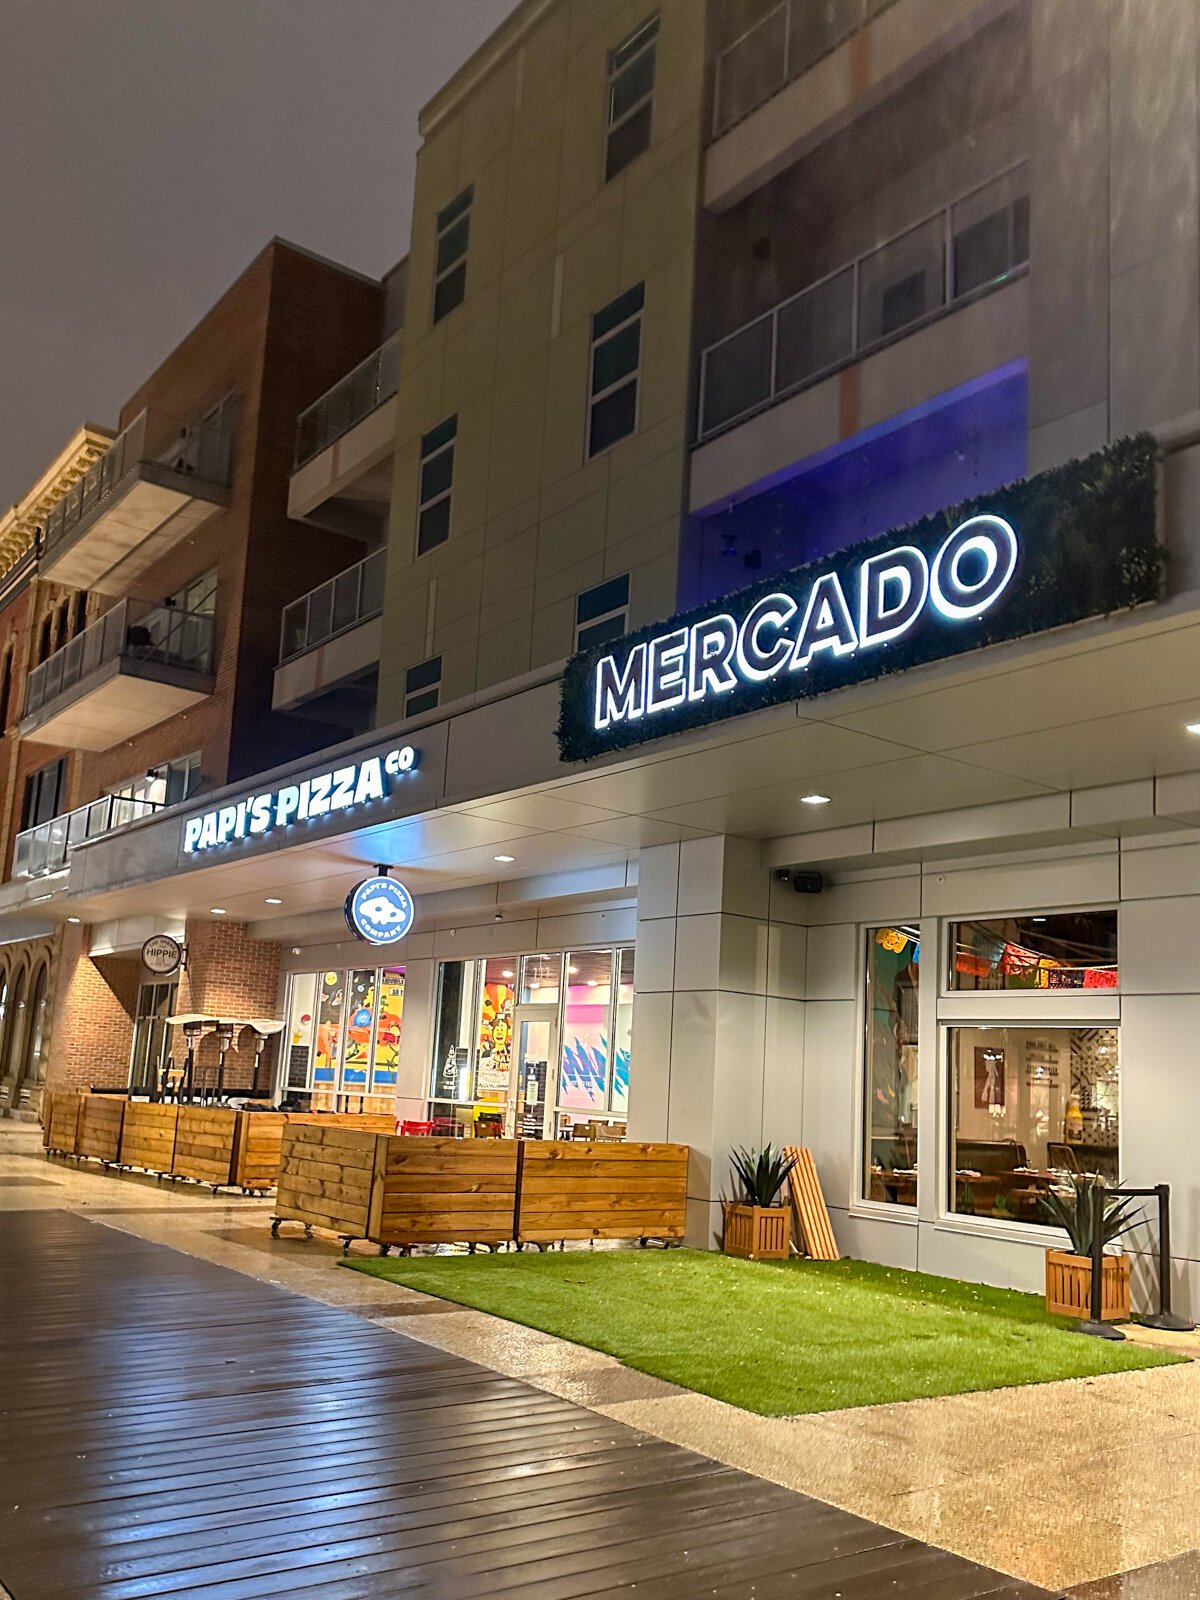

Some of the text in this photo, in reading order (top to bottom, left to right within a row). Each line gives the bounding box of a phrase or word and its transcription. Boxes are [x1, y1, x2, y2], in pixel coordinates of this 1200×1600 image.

[594, 514, 1019, 730] MERCADO
[183, 746, 416, 853] PAPI'S PIZZA CO
[361, 882, 407, 908] PAPI'S PIZZA
[361, 918, 402, 938] COMPANY
[146, 948, 177, 959] HIPPIE
